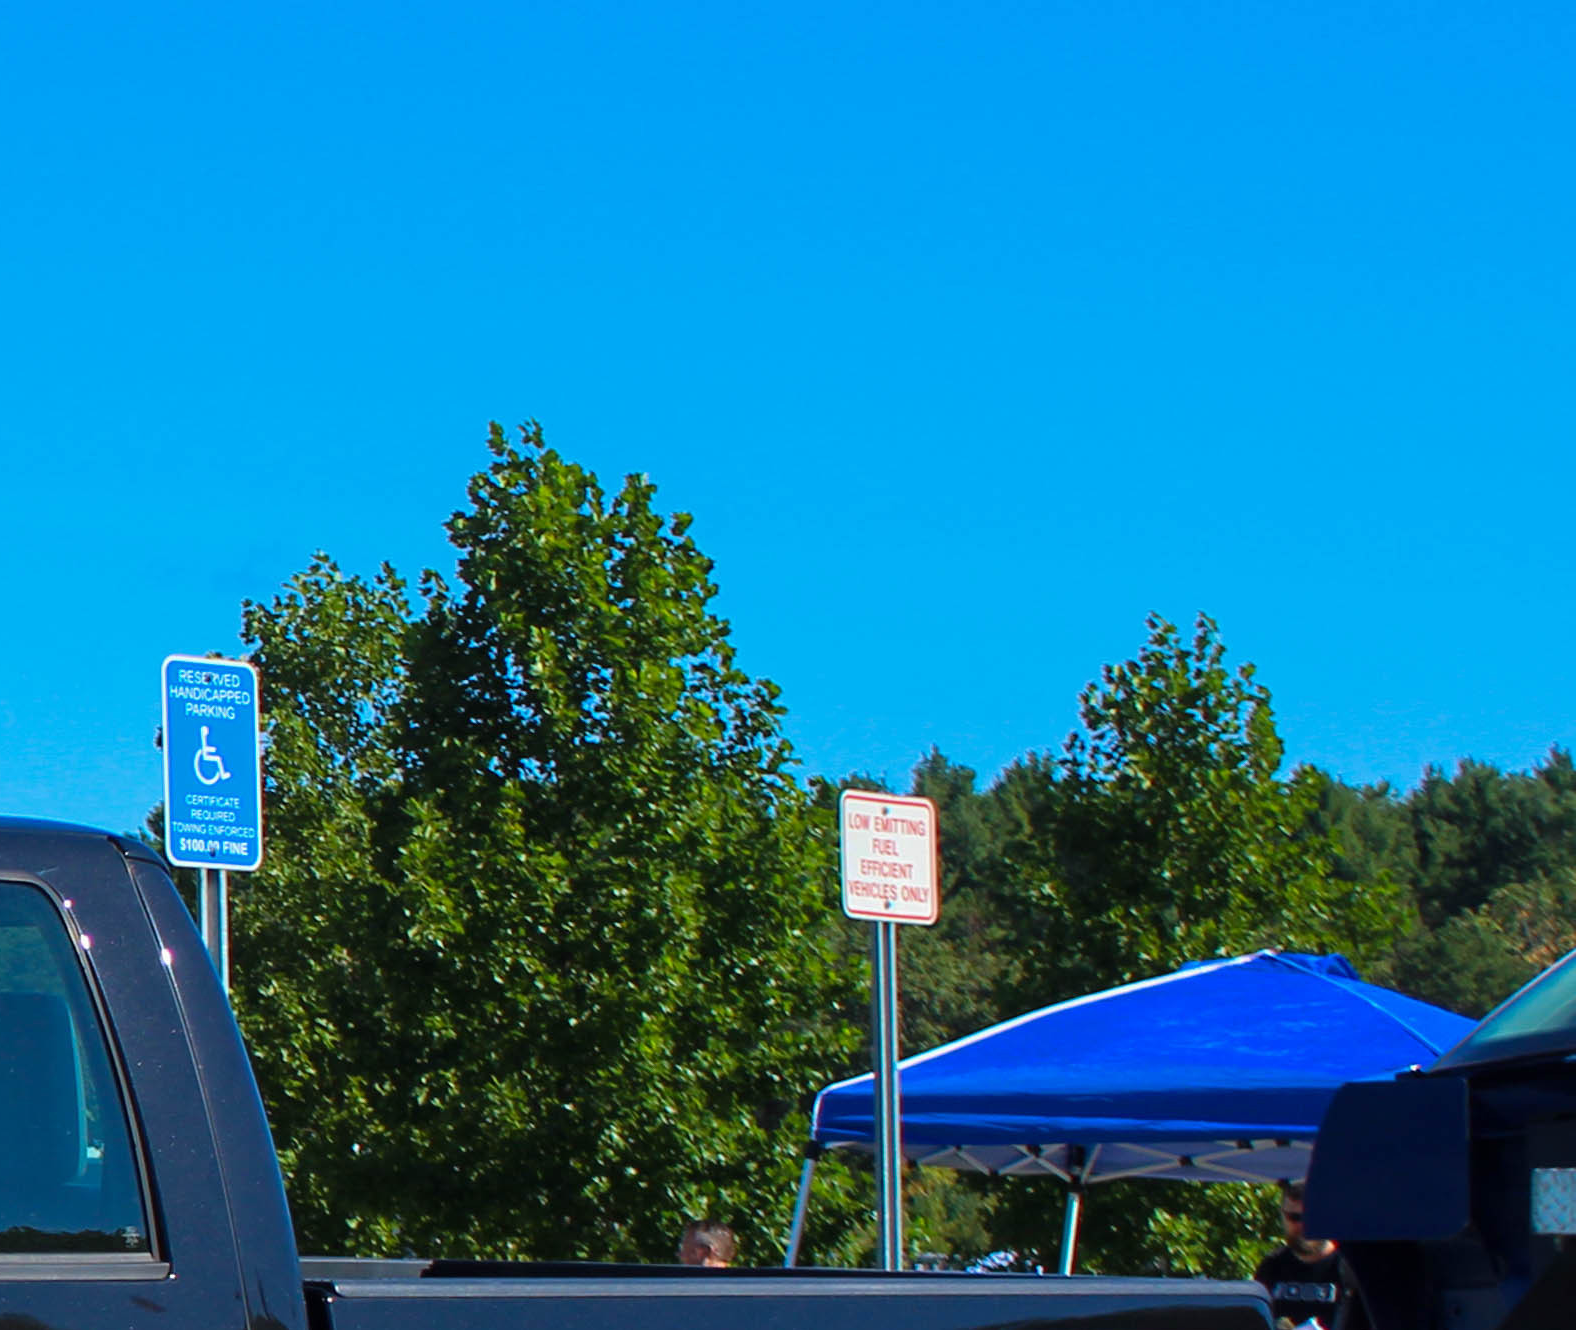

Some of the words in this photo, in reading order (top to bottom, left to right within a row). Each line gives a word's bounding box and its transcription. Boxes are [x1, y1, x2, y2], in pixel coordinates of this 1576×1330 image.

[178, 669, 241, 688] RESERVED
[169, 685, 251, 705] HANDICAPPED
[185, 702, 236, 720] PARKING
[185, 795, 241, 809] CERTIFICATE
[190, 808, 236, 822] REQUIRED
[172, 821, 207, 834] TOWING
[208, 824, 256, 838] ENFORCED
[848, 814, 870, 831] LOW
[874, 817, 926, 837] EMITTING
[222, 841, 249, 856] FINE
[872, 838, 899, 857] FUEL
[859, 859, 914, 880] EFFICIENT
[847, 880, 898, 901] VEHICLES
[900, 885, 930, 904] ONLY
